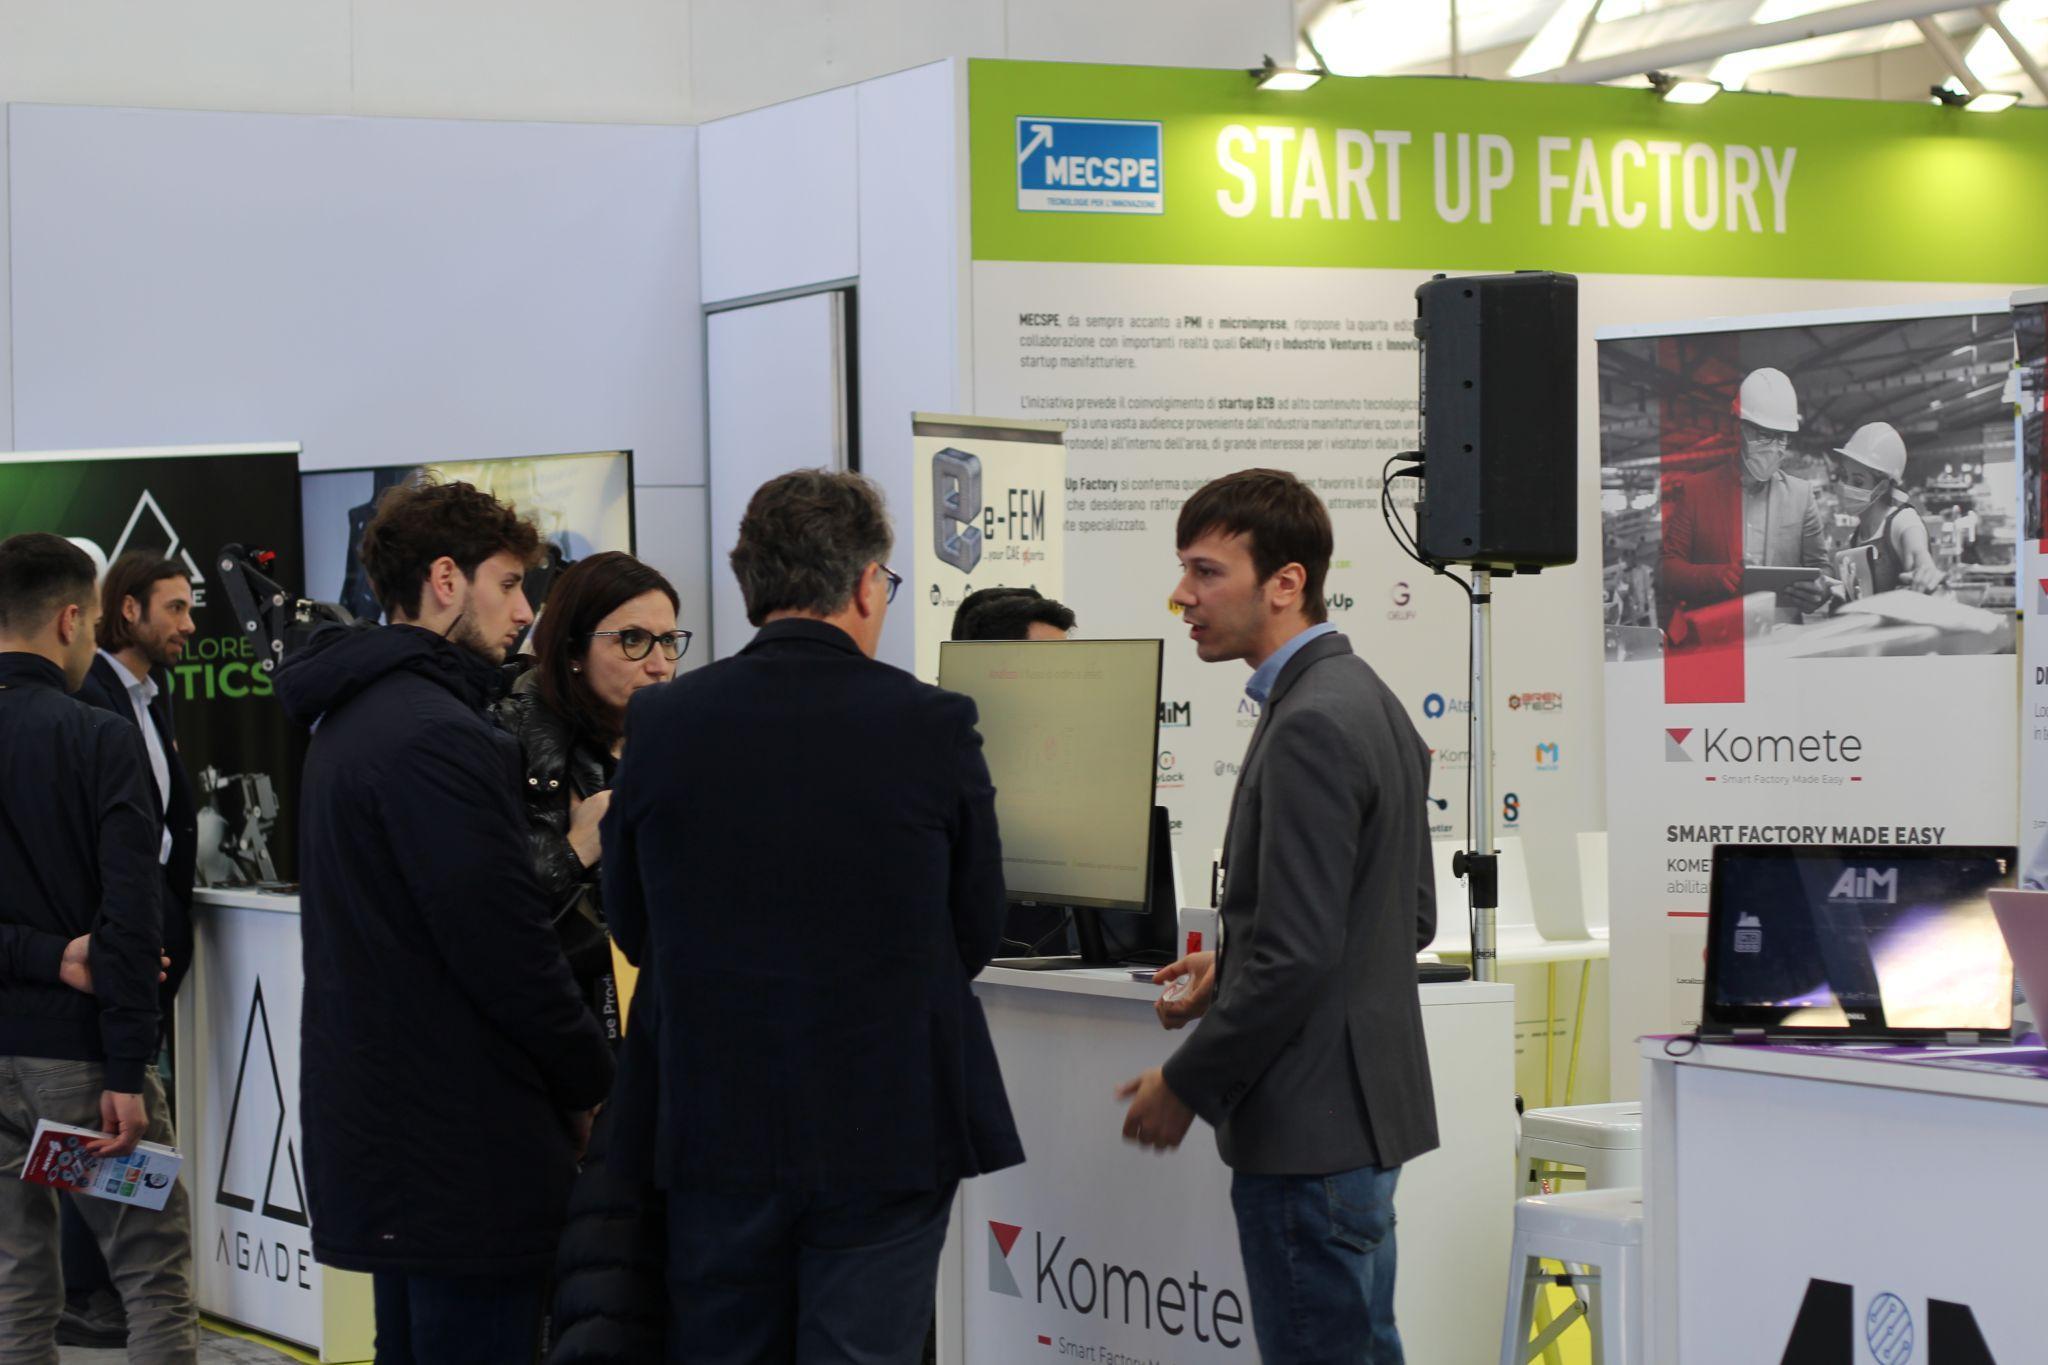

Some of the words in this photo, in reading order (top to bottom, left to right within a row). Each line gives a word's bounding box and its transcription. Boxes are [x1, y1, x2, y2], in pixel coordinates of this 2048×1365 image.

[1045, 155, 1157, 188] MECSPE
[1216, 124, 1411, 221] START
[1433, 131, 1514, 224] UP
[1537, 135, 1797, 233] FACTORY
[1068, 314, 1080, 327] da
[1086, 316, 1124, 330] sempre
[1130, 317, 1170, 328] accanto
[1176, 319, 1182, 328] a
[1184, 316, 1203, 328] PMI
[1208, 319, 1214, 328] e
[1294, 319, 1341, 332] ripropone
[1346, 318, 1355, 331] la
[1358, 319, 1388, 333] quarta
[1019, 334, 1095, 348] collaborazione
[1099, 338, 1118, 348] con
[1122, 336, 1174, 350] importanti
[1179, 336, 1209, 349] realtà
[1213, 338, 1237, 351] quali
[1239, 337, 1271, 351] Gellify
[1274, 341, 1280, 350] e
[1330, 338, 1373, 350] Ventures
[1020, 356, 1058, 370] startup
[1060, 356, 1136, 369] manifatturiere.
[1076, 396, 1117, 411] prevede
[1119, 395, 1125, 409] il
[1127, 396, 1205, 411] coinvolgimento
[1207, 396, 1216, 409] di
[1218, 398, 1253, 412] startup
[1257, 396, 1275, 410] B2B
[1278, 398, 1289, 410] ad
[1292, 398, 1310, 410] alto
[1313, 399, 1361, 410] contenuto
[1089, 420, 1108, 429] una
[1110, 419, 1136, 429] vasta
[1139, 418, 1183, 430] audience
[1186, 418, 1243, 432] proveniente
[1385, 420, 1401, 430] con
[1212, 438, 1221, 449] di
[1224, 438, 1257, 451] grande
[1259, 438, 1304, 449] interesse
[1307, 440, 1323, 451] per
[1331, 438, 1371, 449] visitatori
[1375, 438, 1399, 449] della
[1065, 478, 1078, 491] Up
[1080, 478, 1118, 493] Factory
[1121, 478, 1129, 489] si
[1131, 478, 1180, 490] conferma
[1318, 478, 1356, 490] favorire
[984, 488, 1045, 540] e-FEM
[1067, 499, 1085, 511] che
[1090, 499, 1146, 511] desiderano
[1328, 498, 1377, 509] attraverso
[1078, 519, 1147, 534] specializzato.
[1704, 728, 1862, 762] Komete
[1721, 774, 1751, 784] Smart
[1754, 774, 1790, 785] Factory
[1792, 775, 1820, 784] Made
[1822, 775, 1844, 786] Easy
[1666, 825, 1734, 843] SMART
[1738, 825, 1827, 843] FACTORY
[1832, 826, 1889, 844] MADE
[1896, 826, 1946, 845] EASY
[1828, 867, 1898, 904] AiM
[216, 1229, 312, 1291] AGADE
[1036, 1231, 1244, 1349] Komete
[1058, 1336, 1096, 1362] Smart
